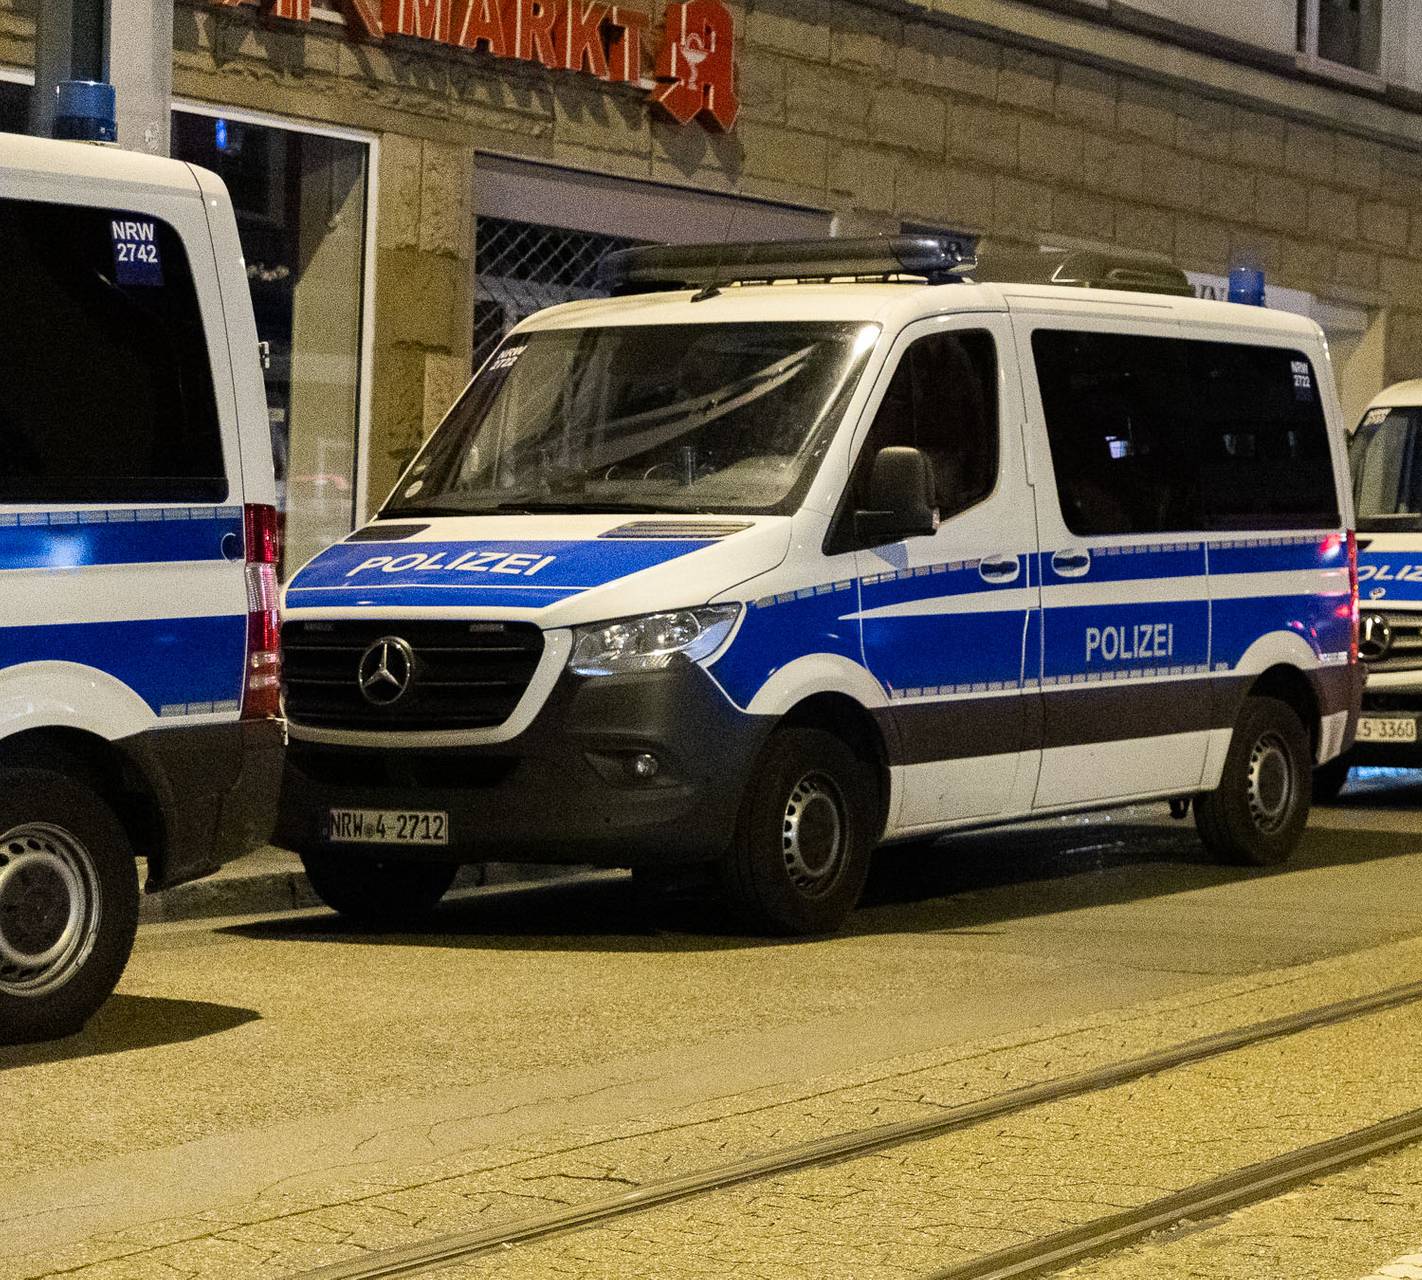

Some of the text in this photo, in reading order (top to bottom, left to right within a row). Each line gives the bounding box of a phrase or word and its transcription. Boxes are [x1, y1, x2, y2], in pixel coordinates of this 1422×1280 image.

[112, 221, 154, 241] NRW
[117, 243, 158, 262] 2742
[346, 551, 556, 577] POLIZEI
[1086, 623, 1173, 662] POLIZEI
